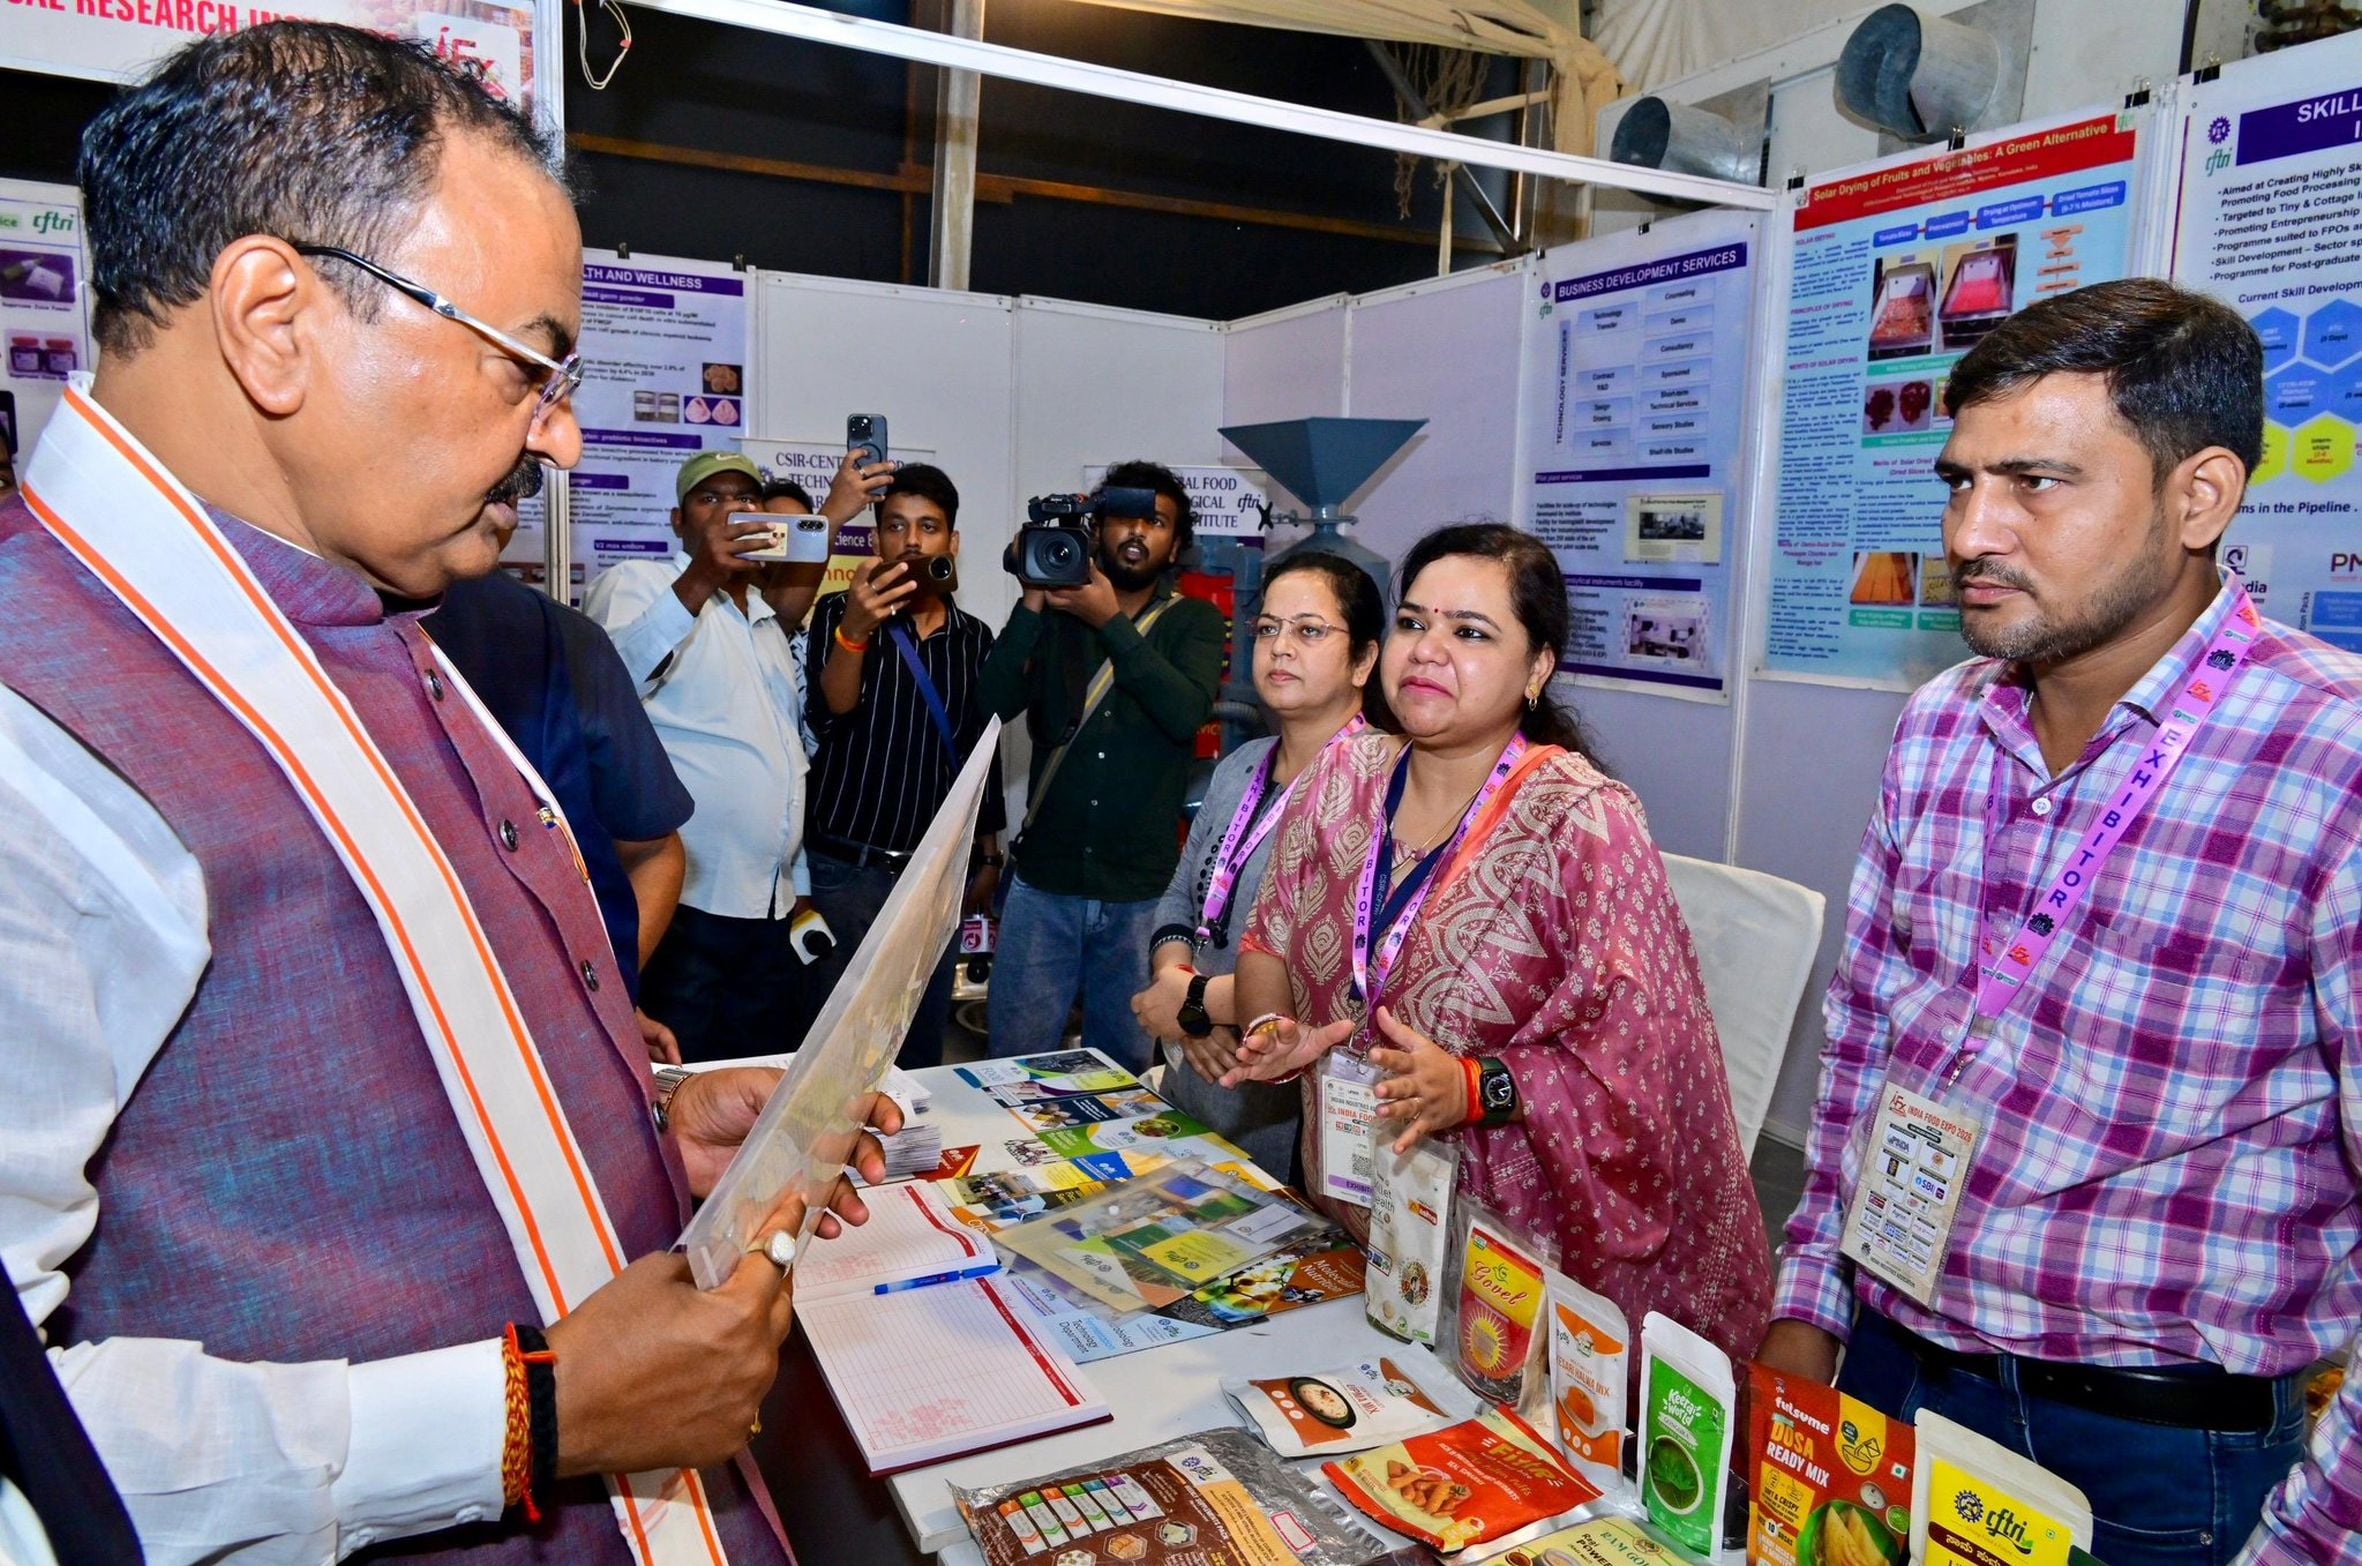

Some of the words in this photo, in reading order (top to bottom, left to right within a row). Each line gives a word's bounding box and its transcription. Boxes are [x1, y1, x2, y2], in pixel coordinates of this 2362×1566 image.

[2297, 93, 2362, 122] SKILL
[1813, 187, 1837, 202] Solar
[1839, 180, 1869, 197] Drying
[1870, 175, 1881, 188] of
[1882, 170, 1911, 185] Fruits
[1912, 166, 1931, 179] and
[1995, 146, 2005, 158] A
[2006, 140, 2041, 156] Green
[2043, 122, 2108, 147] Alternative
[2220, 191, 2271, 209] Promoting
[2274, 186, 2299, 198] Food
[2301, 176, 2361, 197] Processing
[2221, 183, 2253, 197] Aimed
[2255, 181, 2265, 191] at
[2267, 173, 2310, 188] Creating
[2312, 165, 2346, 182] Highly
[2218, 222, 2269, 240] Promoting
[2270, 207, 2361, 230] Entrepreneurship
[2222, 208, 2264, 223] Targeted
[2266, 206, 2276, 216] to
[2279, 202, 2300, 214] Tiny
[2303, 200, 2310, 209] &
[2313, 193, 2355, 209] Cottage
[2214, 252, 2237, 267] Skill
[2238, 246, 2304, 264] Development
[2313, 239, 2348, 254] Sector
[2216, 236, 2273, 252] Programme
[2275, 230, 2307, 244] suited
[2308, 228, 2319, 239] to
[2321, 223, 2350, 236] FPOs
[605, 270, 633, 282] AND
[634, 271, 703, 290] WELLNESS
[1558, 279, 1605, 299] BUSINESS
[1606, 262, 1681, 289] DEVELOPMENT
[1682, 249, 1738, 273] SERVICES
[2213, 267, 2271, 283] Programme
[2272, 263, 2286, 275] for
[2288, 253, 2361, 272] Post-graduate
[2238, 290, 2280, 304] Current
[2281, 284, 2306, 299] Skill
[1560, 329, 1568, 378] SERVICES
[1556, 380, 1567, 445] TECHNOLOGY
[1202, 477, 1237, 491] FOOD
[2257, 502, 2271, 514] in
[2274, 501, 2295, 514] the
[2297, 500, 2351, 516] Pipeline
[2047, 730, 2179, 908] EXHIBITOR
[1337, 1107, 1358, 1119] INDIA
[1907, 1104, 1924, 1120] INDIA
[1924, 1112, 1941, 1127] FOOD
[1941, 1119, 1958, 1136] EXPO
[1300, 1265, 1344, 1293] Nutrition
[1312, 1259, 1362, 1290] Molecular
[1058, 1320, 1090, 1355] Department
[1774, 1395, 1831, 1437] fulsome
[1766, 1440, 1807, 1473] READY
[1804, 1462, 1830, 1489] MIX
[1985, 1507, 2029, 1544] cftri
[1600, 1530, 1628, 1555] RAM
